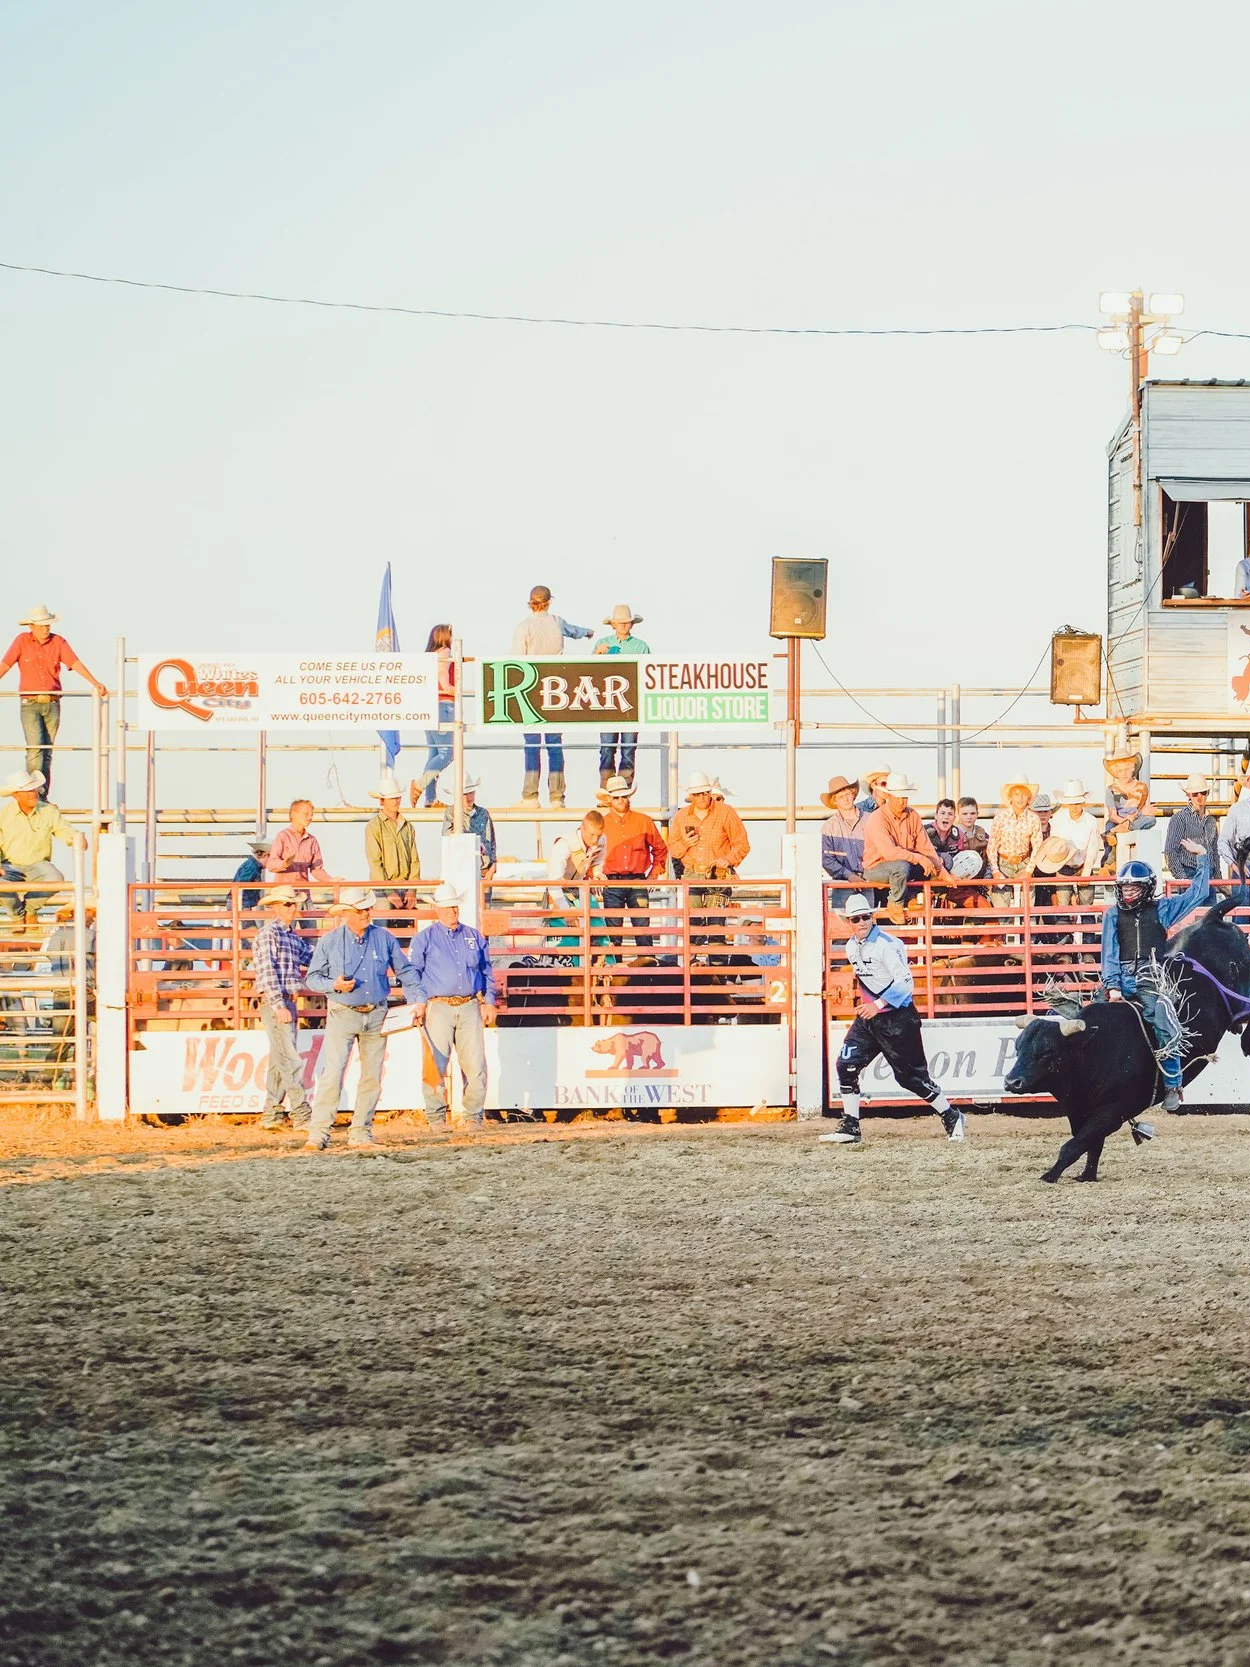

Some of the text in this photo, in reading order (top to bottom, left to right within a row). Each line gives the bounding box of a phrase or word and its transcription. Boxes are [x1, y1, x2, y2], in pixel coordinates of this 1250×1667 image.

[299, 662, 403, 671] COME SEE US FOR
[645, 662, 768, 690] STEAKHOUSE
[275, 675, 427, 684] ALL YOUR VEHICLE NEEDS!
[147, 658, 258, 721] Queen
[299, 692, 402, 705] 605-642-2766
[488, 661, 634, 724] R BAR
[270, 711, 431, 723] www.queencitymotors.com
[648, 696, 766, 720] LIQUOR STORE
[770, 982, 786, 1002] 2
[199, 1095, 244, 1109] FEED
[553, 1085, 712, 1104] BANK OF THE WEST
